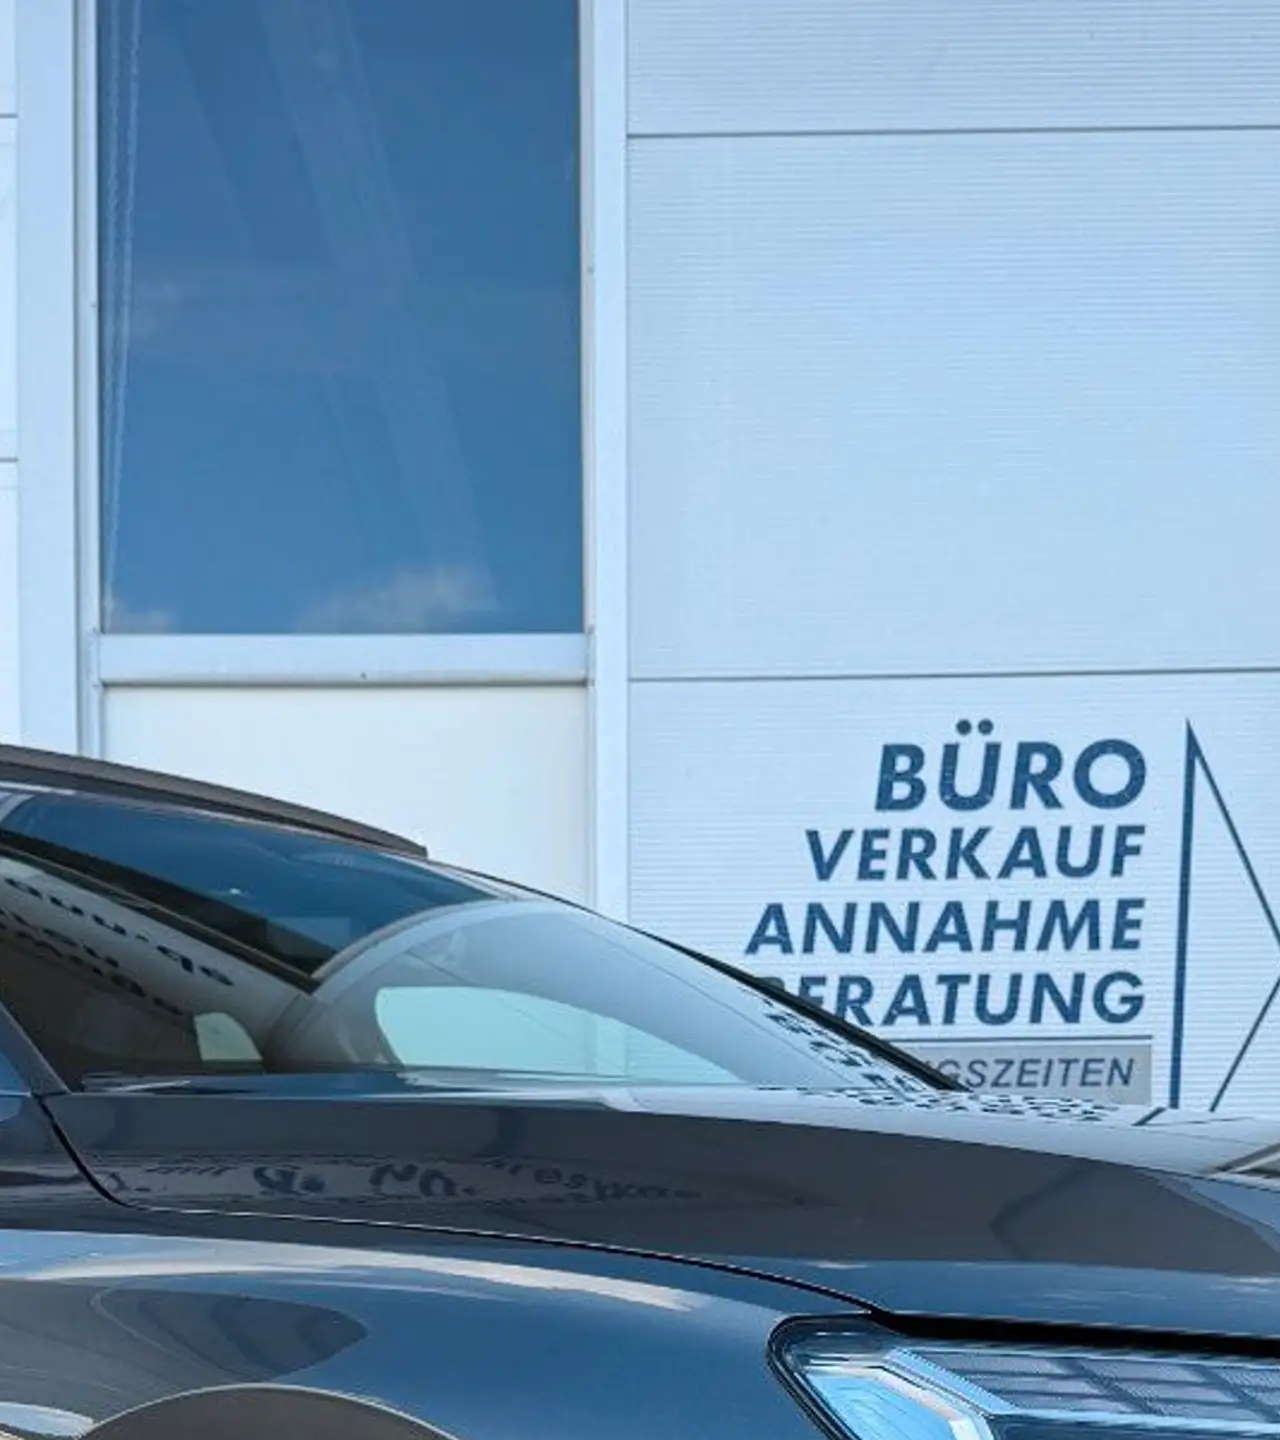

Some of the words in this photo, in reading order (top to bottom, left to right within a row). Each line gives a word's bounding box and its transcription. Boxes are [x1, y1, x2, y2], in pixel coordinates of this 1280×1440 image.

[874, 718, 1147, 812] BÜRO
[805, 825, 1146, 881] VERKAUF
[745, 898, 1146, 954] ANNAHME
